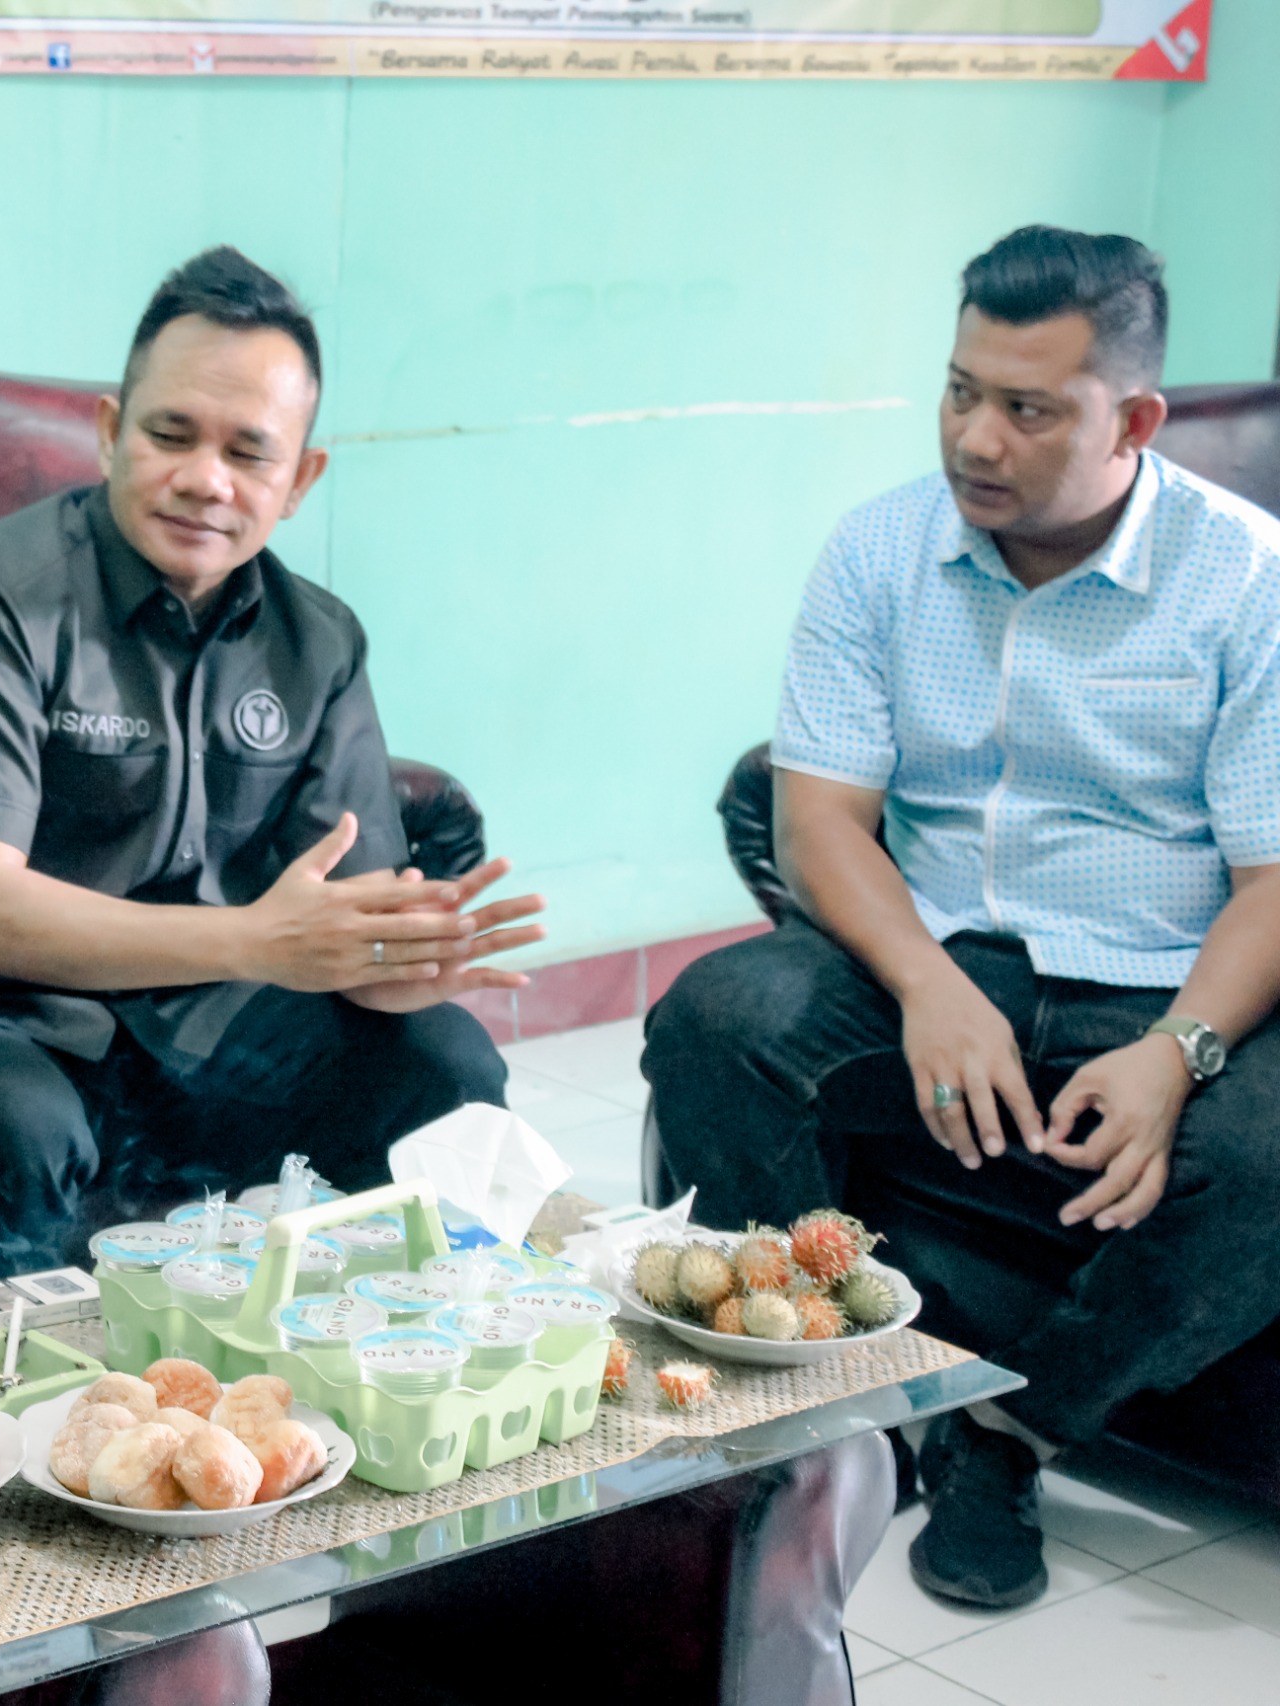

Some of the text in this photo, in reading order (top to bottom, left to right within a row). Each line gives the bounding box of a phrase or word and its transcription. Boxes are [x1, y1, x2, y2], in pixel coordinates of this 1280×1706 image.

[51, 710, 150, 738] ISKARDO
[107, 1234, 189, 1245] GRAND
[374, 1275, 447, 1299] GRAND
[515, 1297, 601, 1312] GRAND
[364, 1350, 454, 1358] GRAND
